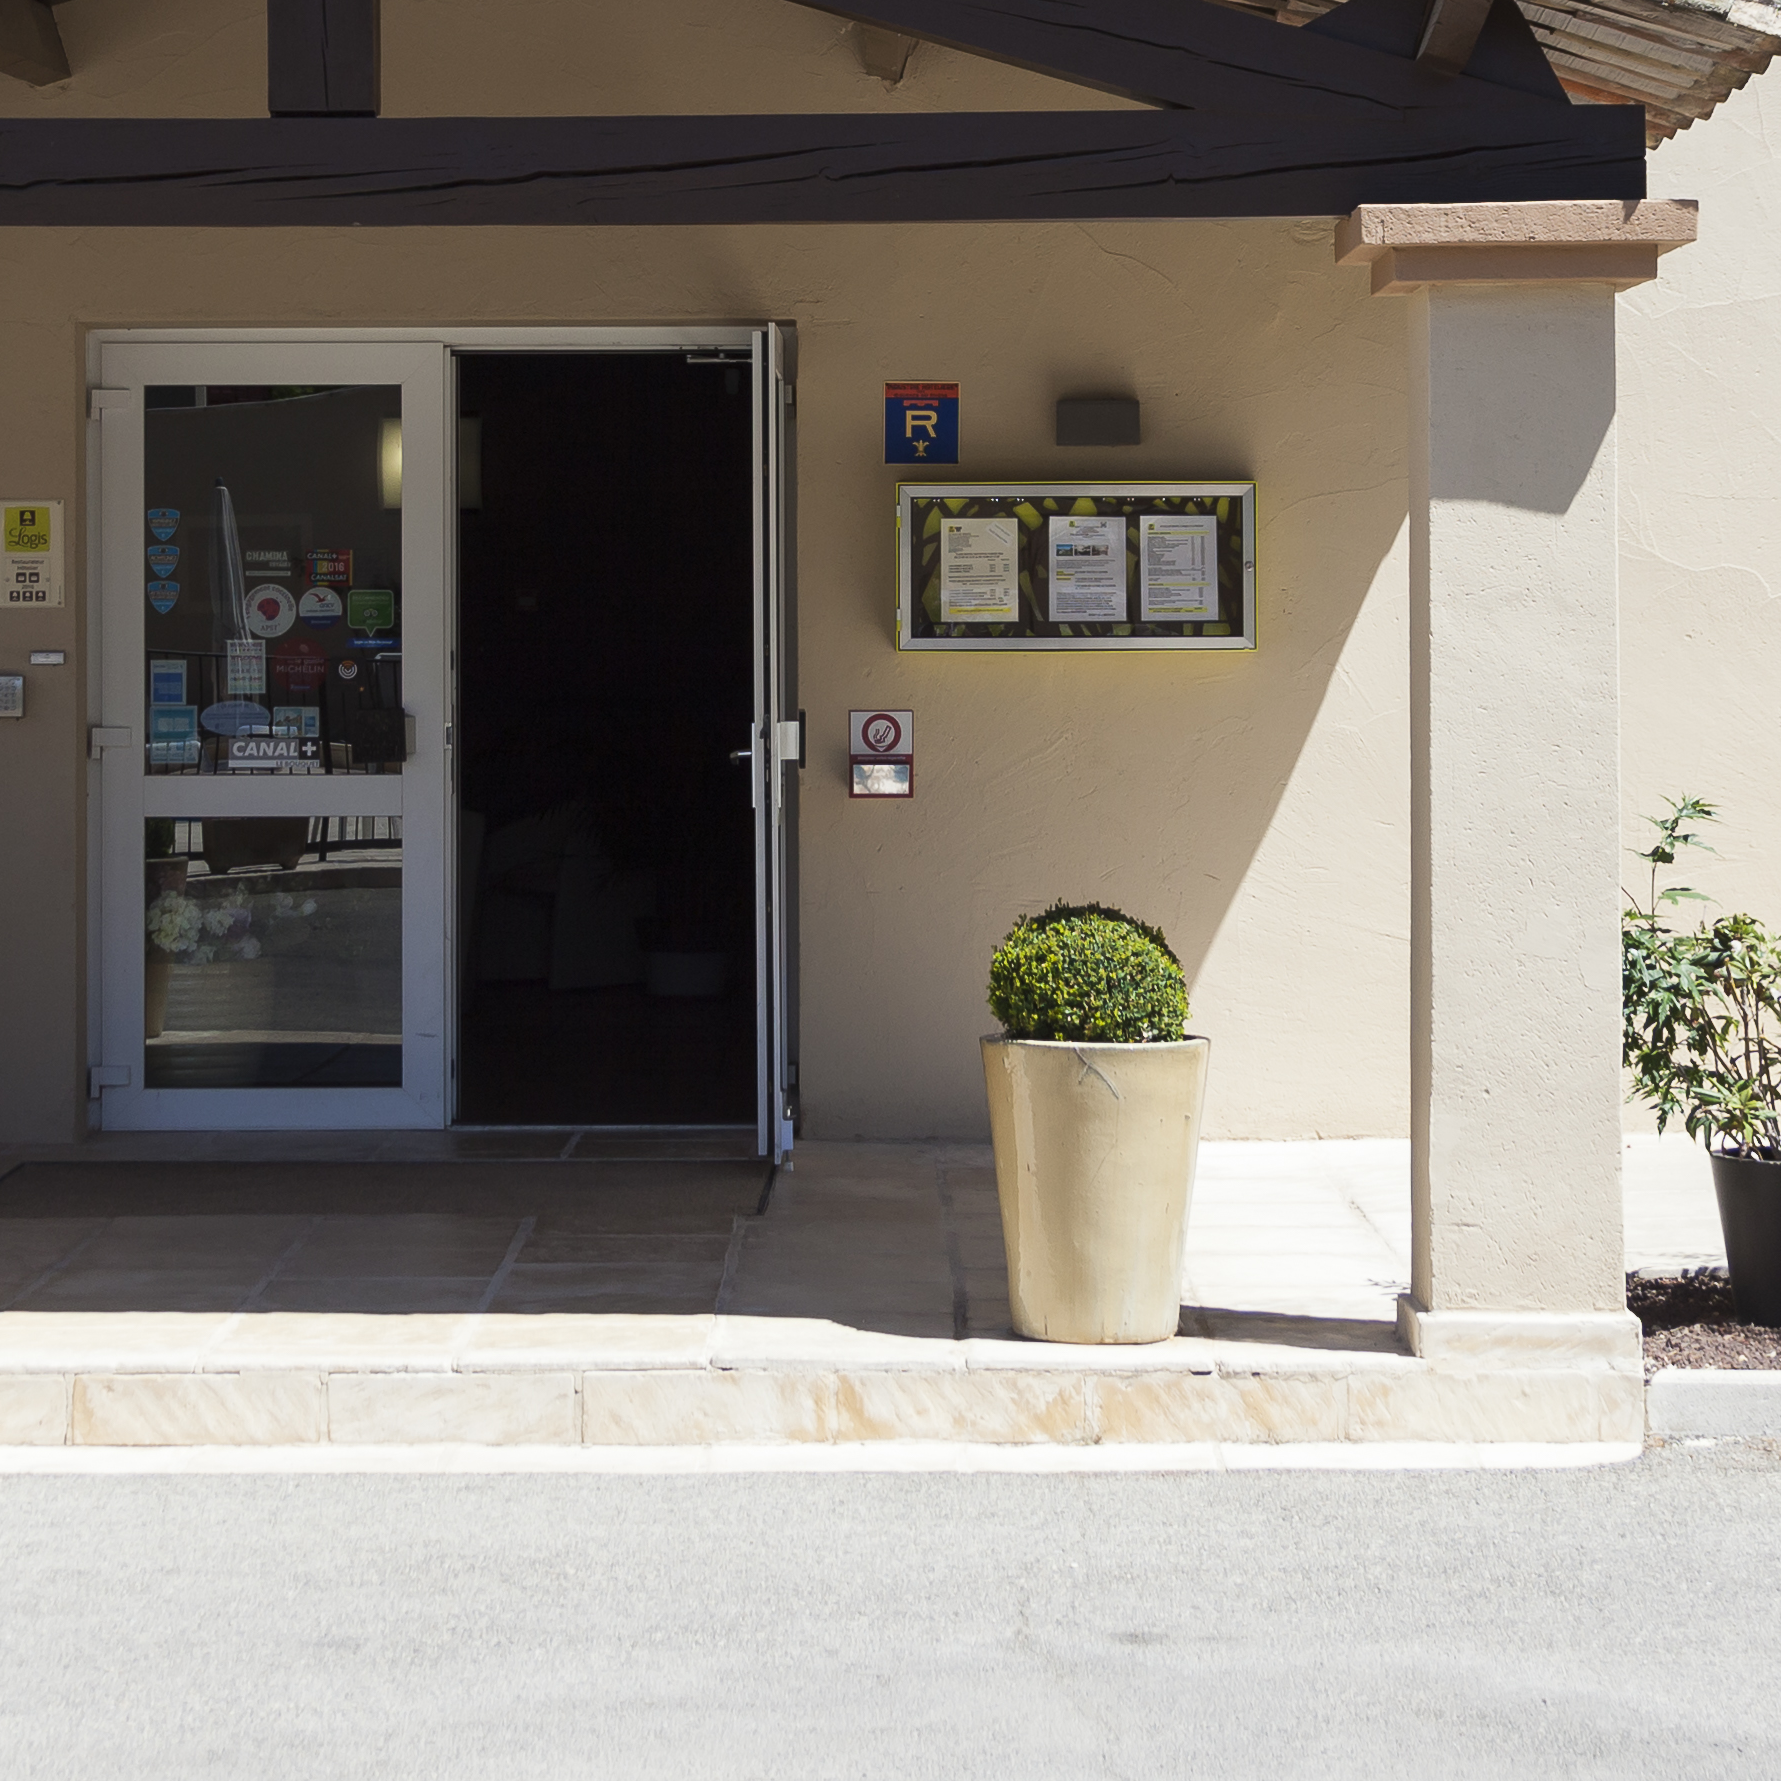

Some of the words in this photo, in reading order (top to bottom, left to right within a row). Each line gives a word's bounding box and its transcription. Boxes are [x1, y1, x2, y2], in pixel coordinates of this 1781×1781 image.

[905, 410, 938, 438] R
[8, 527, 48, 549] Logis
[322, 562, 345, 571] 2016
[276, 665, 325, 673] MICHELIN
